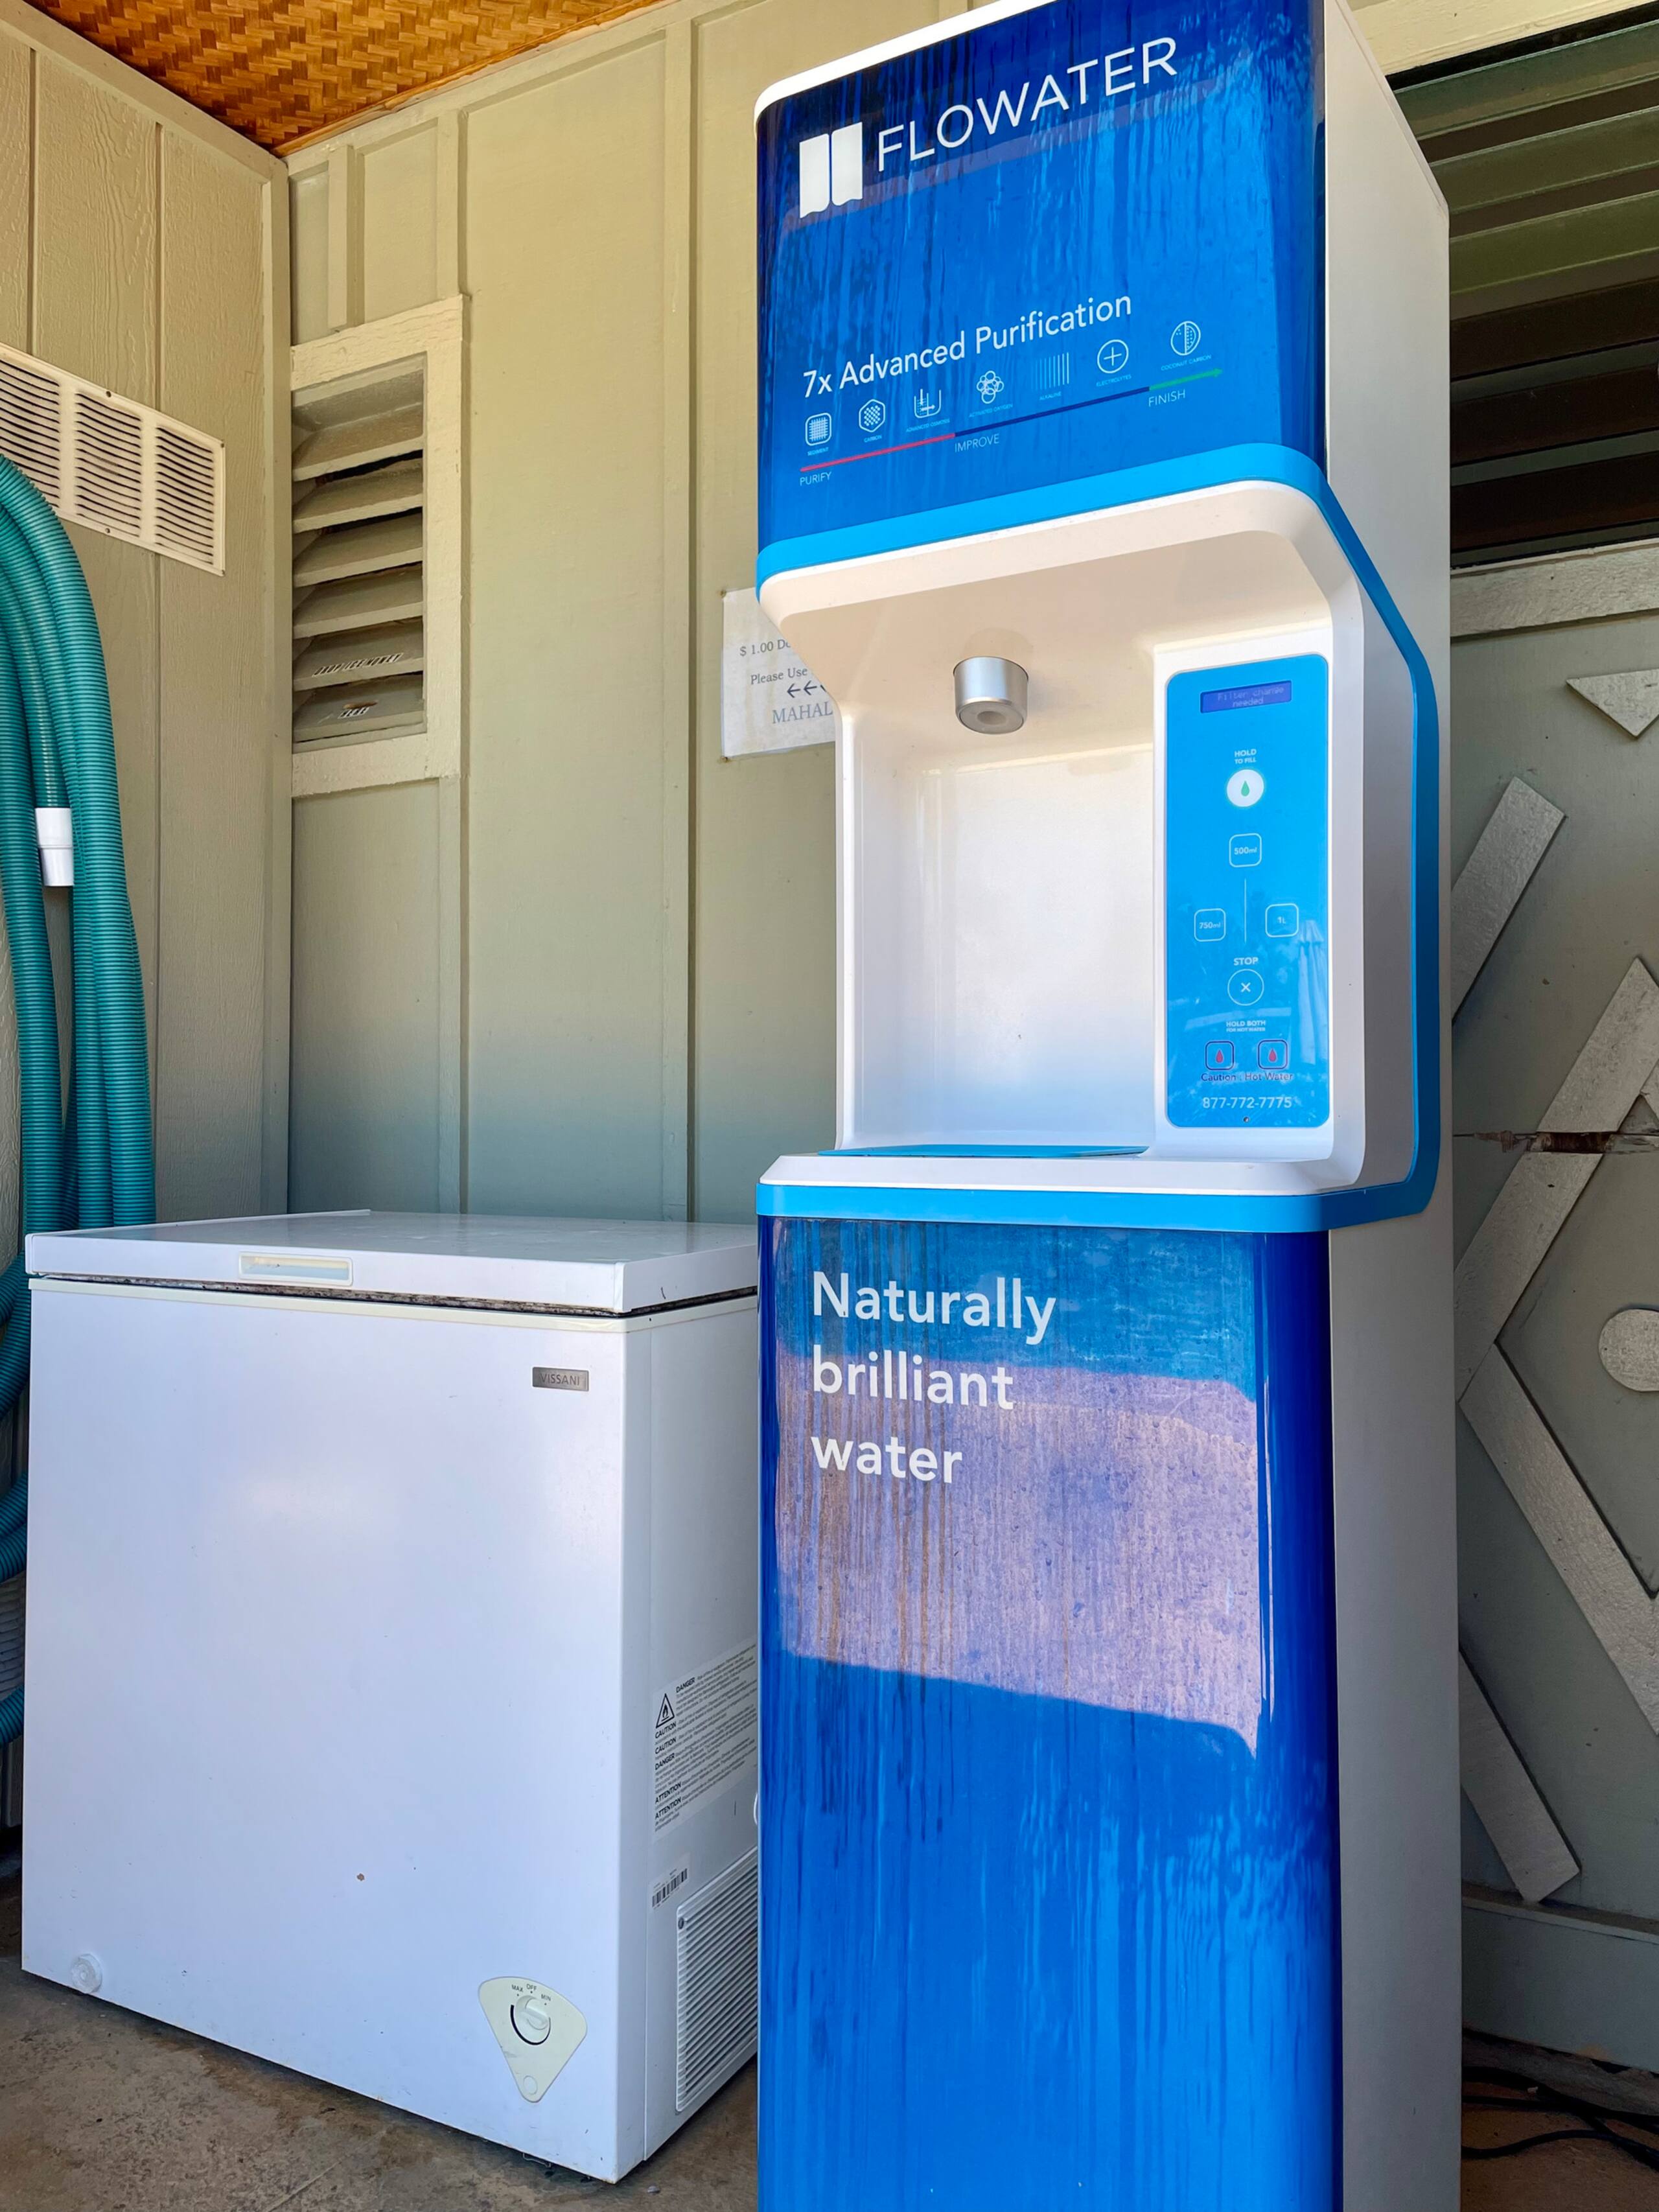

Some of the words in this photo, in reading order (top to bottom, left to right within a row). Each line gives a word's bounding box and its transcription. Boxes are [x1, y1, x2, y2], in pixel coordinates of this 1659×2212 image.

[878, 37, 1178, 172] FLOWATER
[803, 369, 833, 398] 7x
[839, 331, 965, 389] Advanced
[975, 296, 1131, 354] Purification
[1148, 389, 1185, 407] FINISH
[955, 433, 999, 453] IMPROVE
[800, 471, 831, 486] PURIFY
[739, 646, 747, 657] $
[751, 641, 774, 655] 1.00
[750, 671, 784, 685] Please
[788, 667, 808, 679] Use
[1218, 692, 1247, 701] Filter
[1232, 697, 1264, 708] needed
[1234, 749, 1257, 758] HOLD
[1234, 846, 1257, 856] 500ml
[1199, 921, 1222, 929] 750ml
[1233, 957, 1259, 966] STOP
[1201, 1073, 1236, 1082] Caution
[1245, 1072, 1262, 1081] Hot
[1264, 1071, 1294, 1081] Water
[1202, 1097, 1293, 1109] 877-772-7775
[813, 1271, 1056, 1345] Naturally
[539, 1373, 580, 1386] VISSANI
[813, 1344, 1014, 1410] brilliant
[811, 1436, 963, 1484] water
[676, 1677, 696, 1694] DANGER
[655, 1721, 677, 1739] CAUTION
[655, 1737, 677, 1754] CAUTION
[655, 1752, 675, 1770] DANGER
[655, 1782, 682, 1804] ATTENTION
[655, 1796, 682, 1820] ATTENTION
[512, 1984, 524, 1992] MAX
